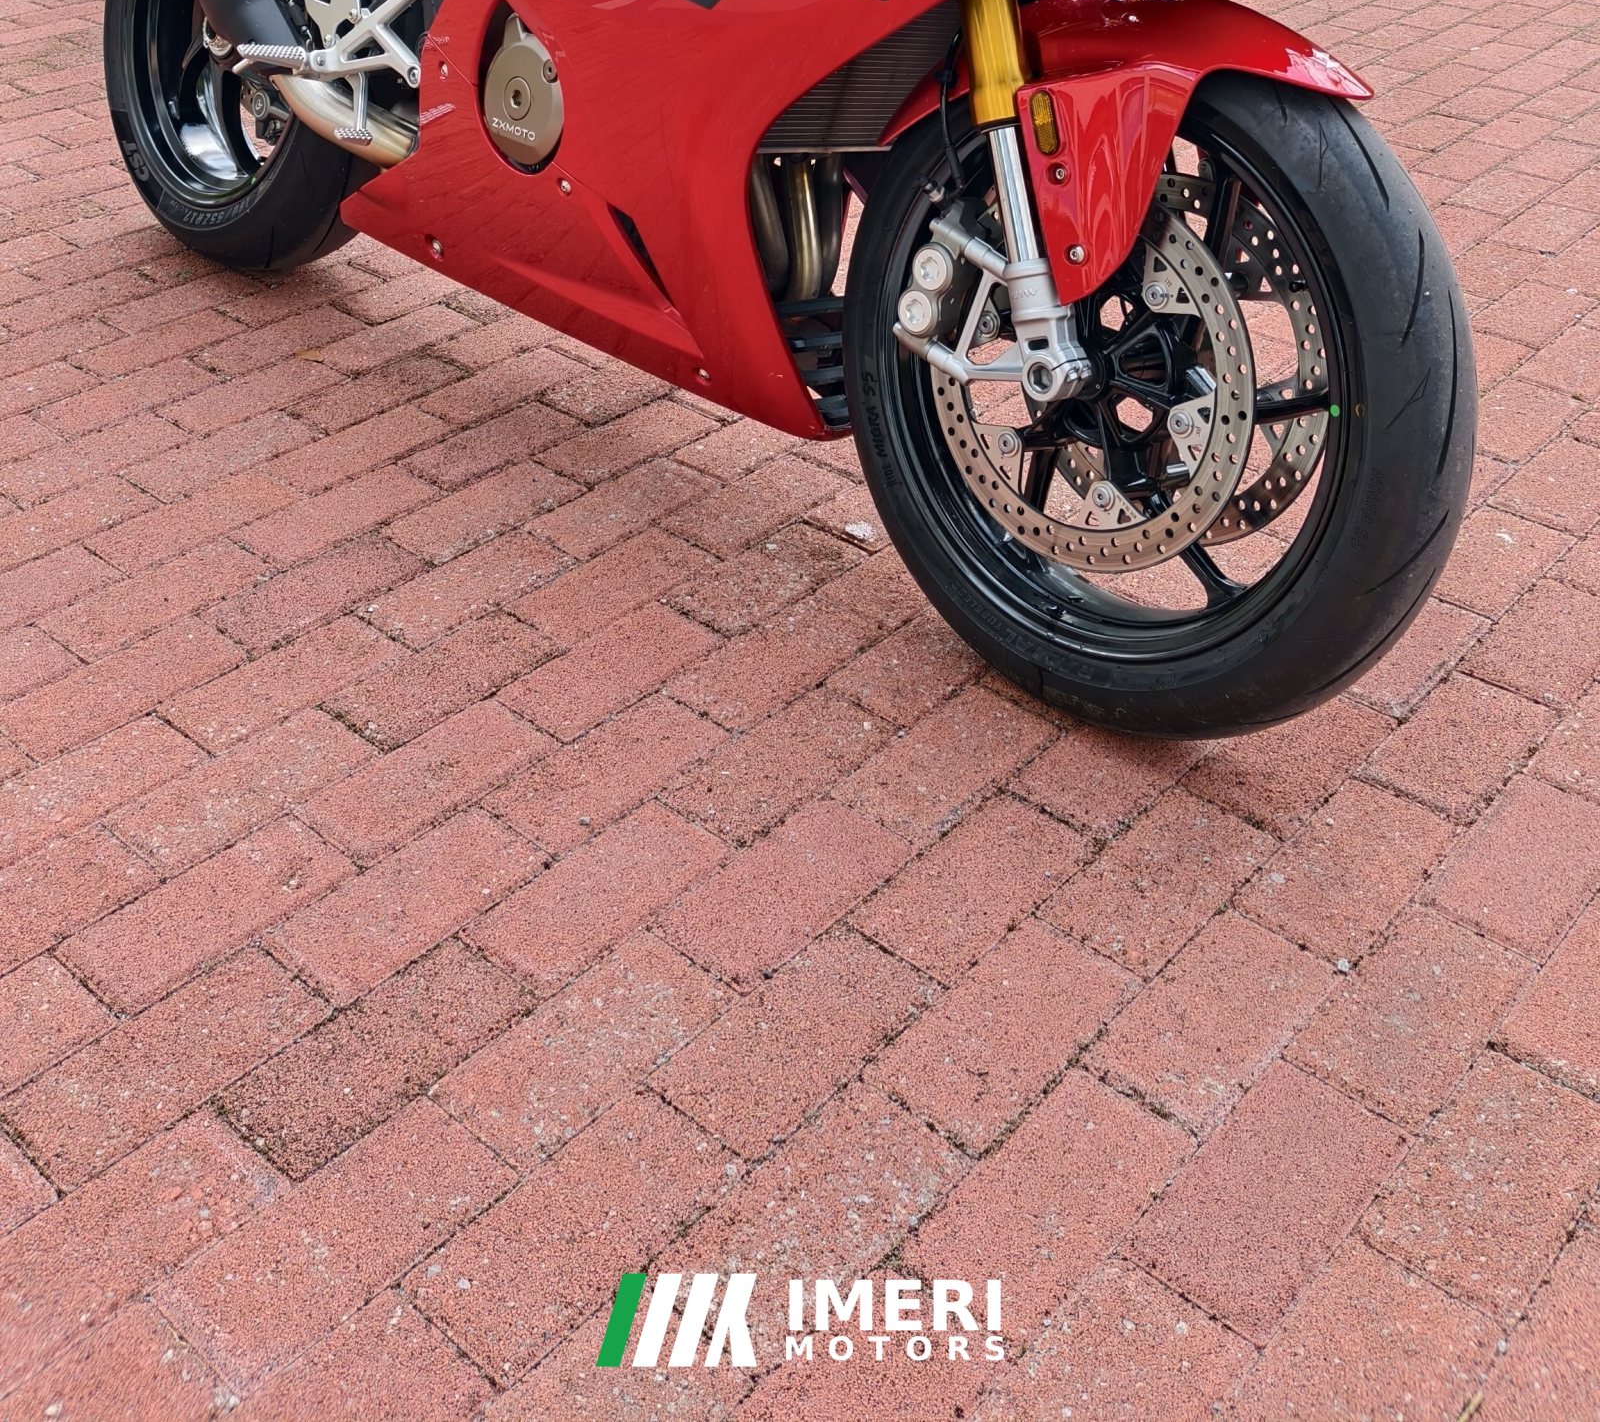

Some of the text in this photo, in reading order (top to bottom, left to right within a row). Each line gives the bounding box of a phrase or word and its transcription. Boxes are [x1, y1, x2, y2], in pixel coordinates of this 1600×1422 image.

[491, 117, 537, 141] ZXMOTO
[121, 139, 151, 182] CST
[865, 405, 888, 458] MIGRA
